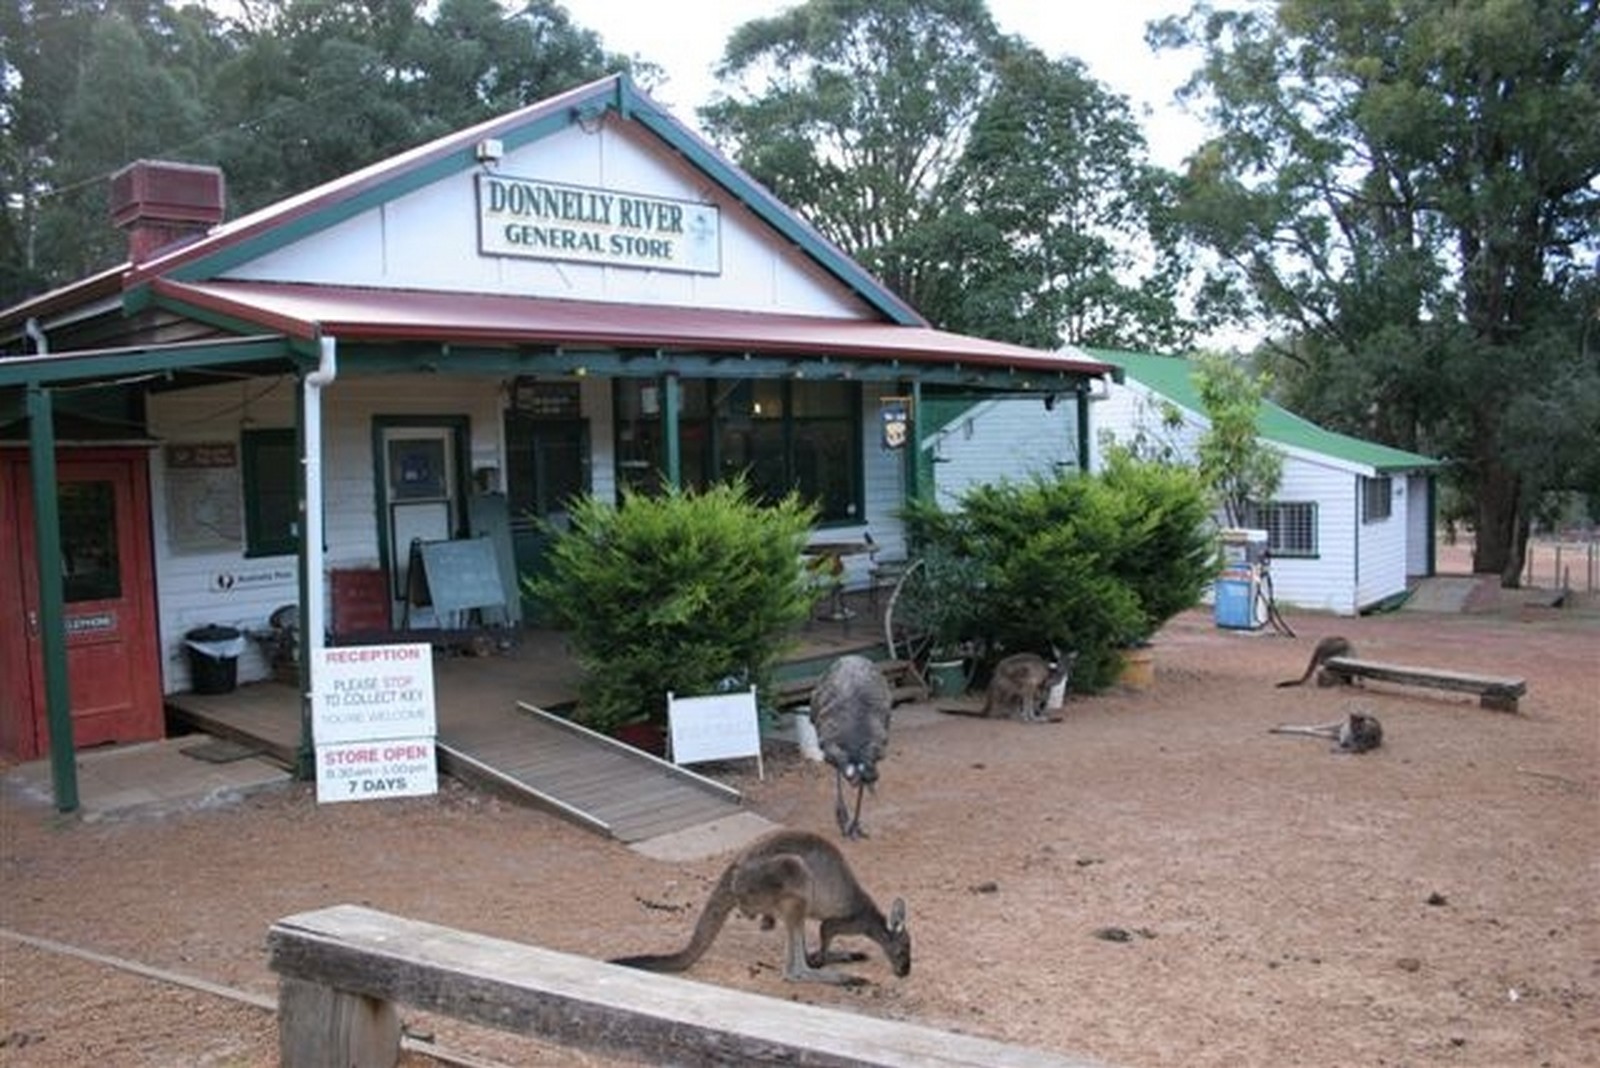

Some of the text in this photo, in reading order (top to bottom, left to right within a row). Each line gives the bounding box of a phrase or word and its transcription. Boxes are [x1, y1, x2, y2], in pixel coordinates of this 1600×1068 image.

[488, 180, 684, 234] DONNELLY RIVER
[505, 223, 673, 260] GENERAL STORE
[325, 647, 420, 664] RECEPTION
[334, 675, 414, 691] PLEASE STOP
[325, 689, 424, 707] TO COLLECT KEY
[325, 746, 428, 765] STORE OPEN
[348, 777, 407, 794] 7 DAYS
